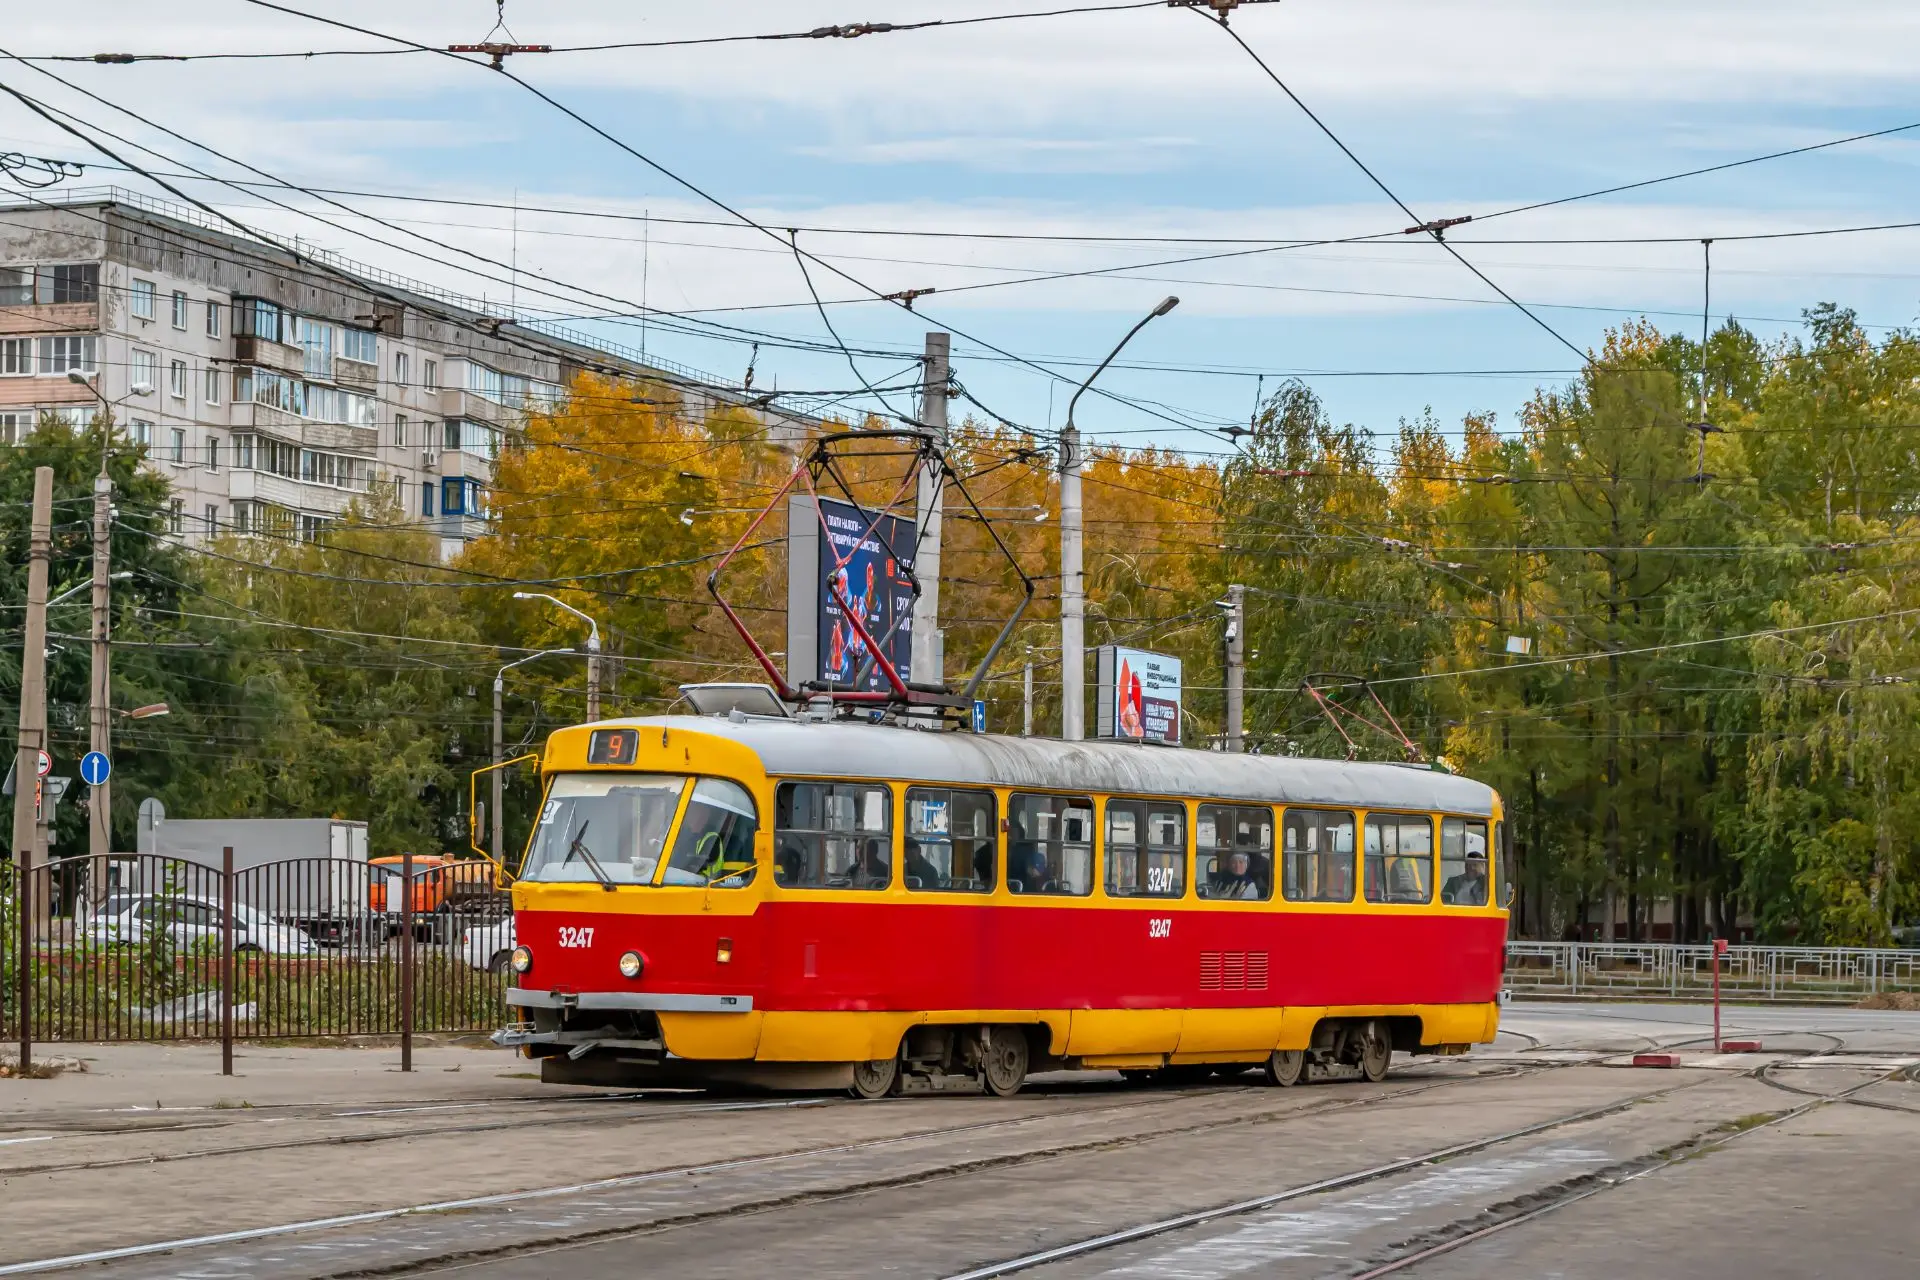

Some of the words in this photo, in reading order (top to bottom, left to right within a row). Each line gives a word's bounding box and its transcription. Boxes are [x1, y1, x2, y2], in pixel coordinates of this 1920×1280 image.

[609, 736, 622, 758] 9
[542, 801, 553, 820] 9
[1148, 868, 1173, 891] 3247
[559, 927, 594, 948] 3247
[1150, 919, 1171, 937] 3247
